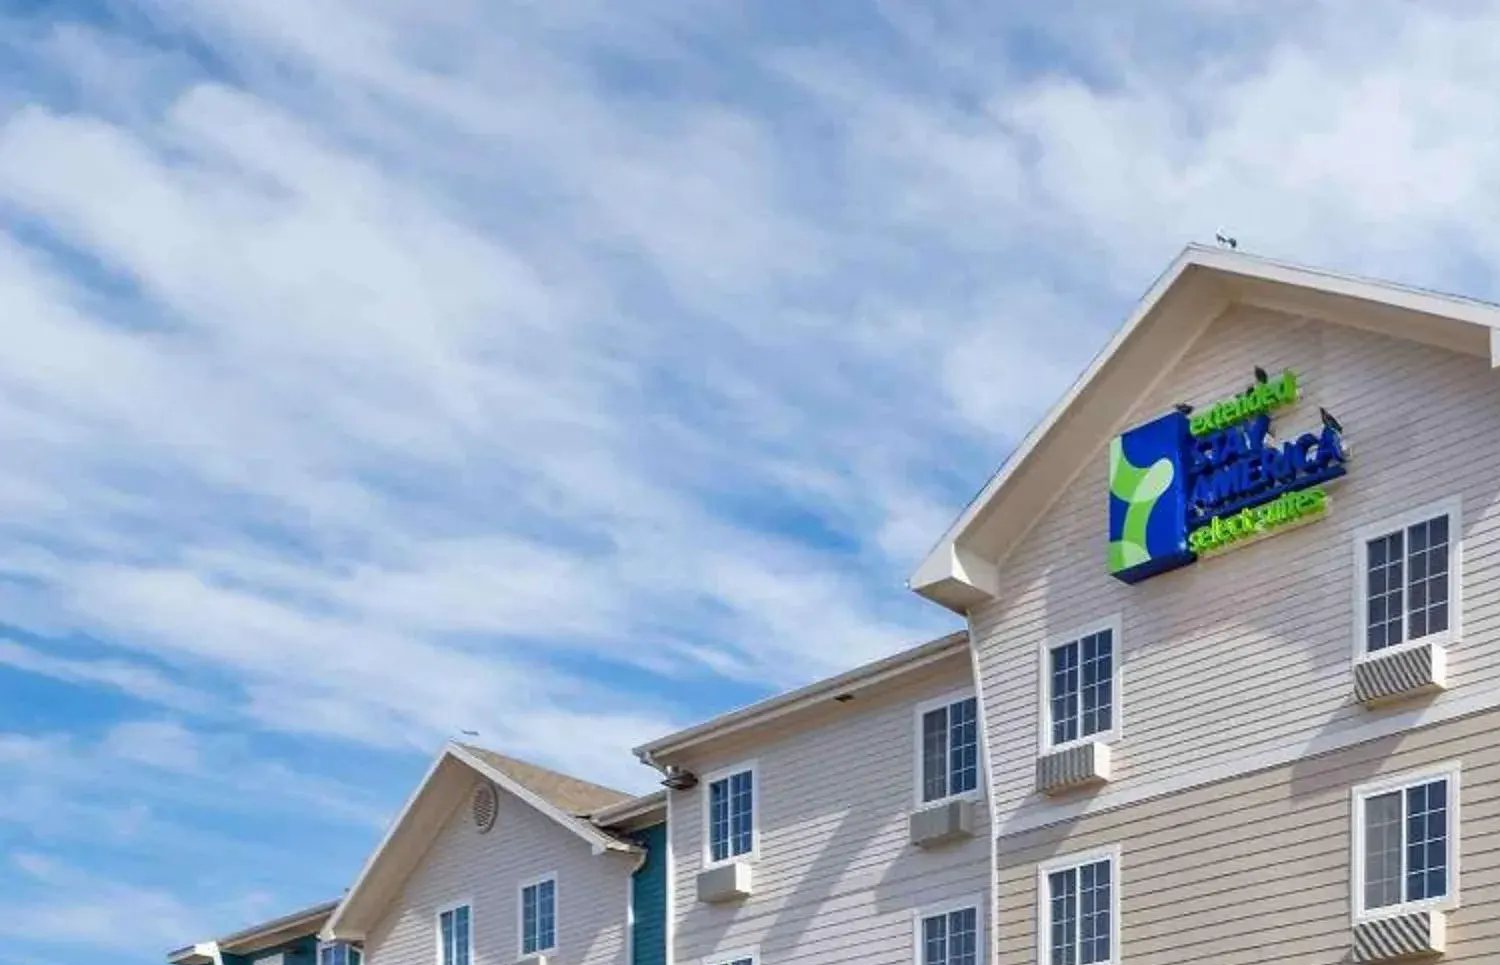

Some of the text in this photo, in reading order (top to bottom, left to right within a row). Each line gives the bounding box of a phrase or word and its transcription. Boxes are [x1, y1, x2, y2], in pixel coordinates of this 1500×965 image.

[1190, 370, 1299, 436] extended
[1191, 413, 1270, 475] STAY
[1191, 425, 1346, 511] AMERICA
[1189, 488, 1328, 552] select suites
